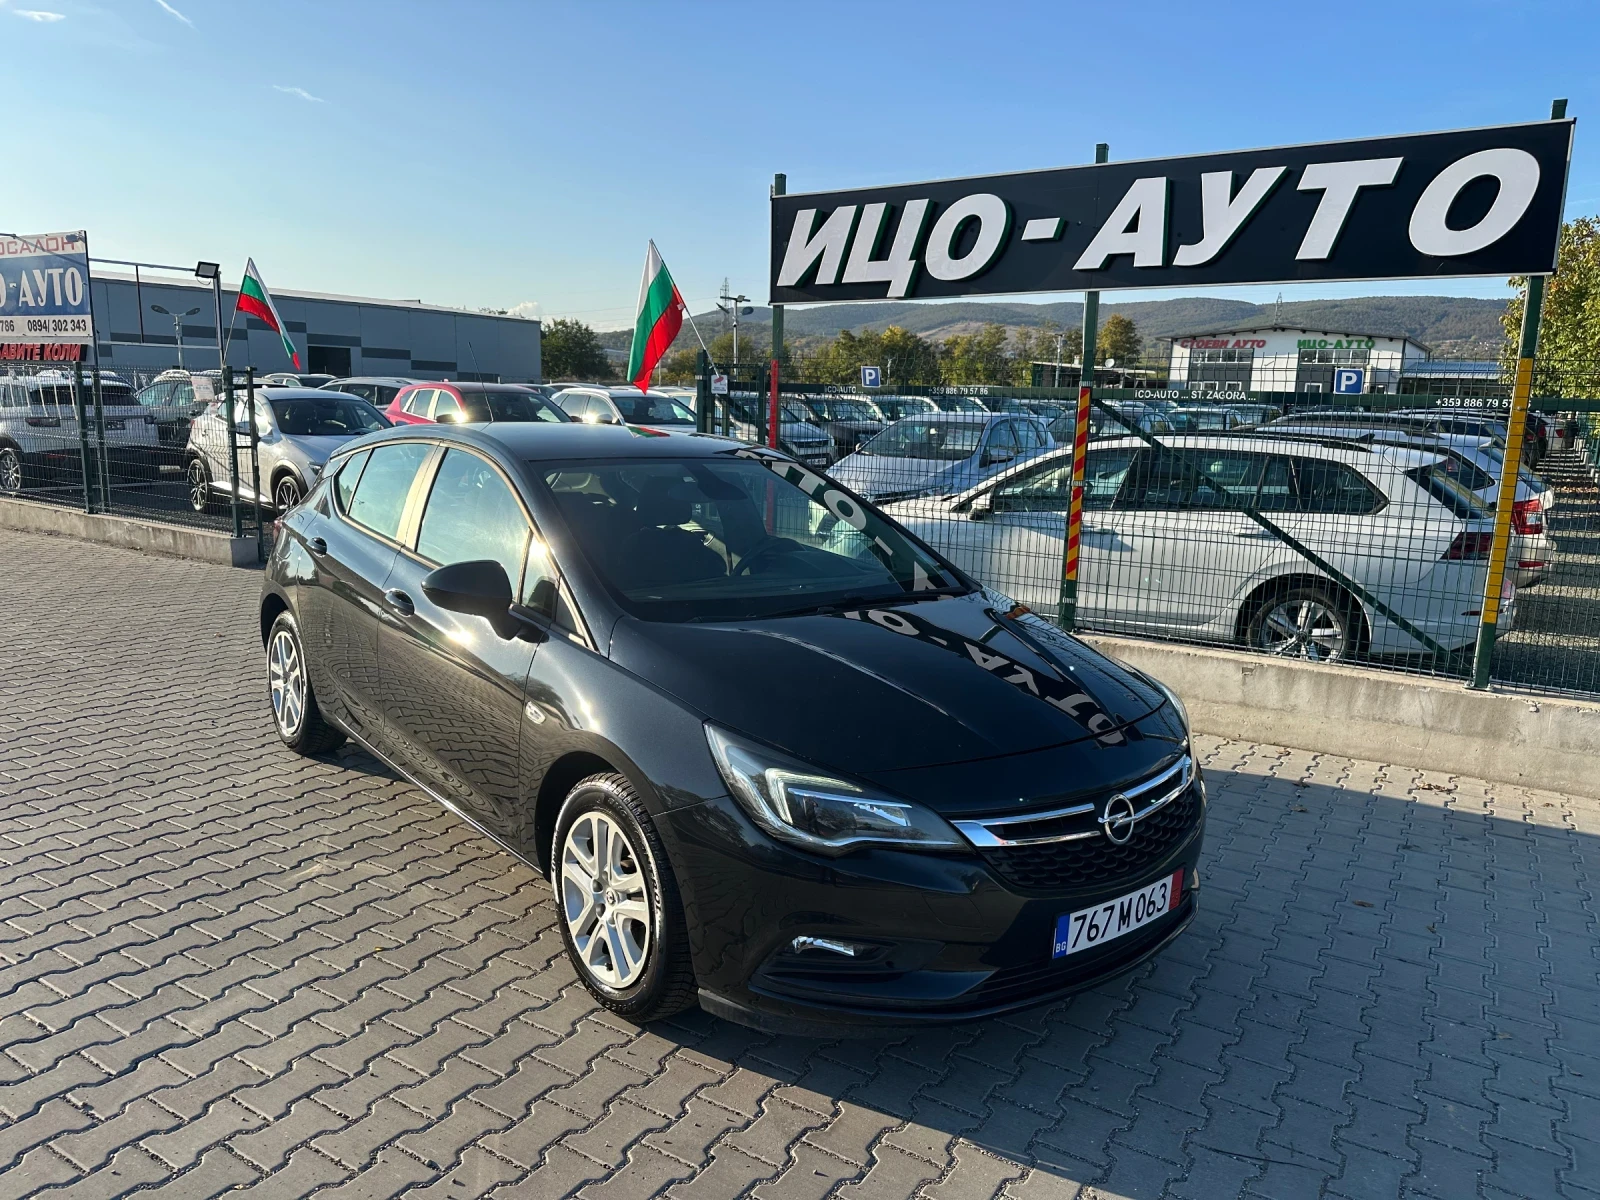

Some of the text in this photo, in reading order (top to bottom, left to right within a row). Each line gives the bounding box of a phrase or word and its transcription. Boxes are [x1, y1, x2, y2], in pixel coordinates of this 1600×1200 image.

[776, 147, 1541, 298] ИЦО-АУТО
[52, 319, 68, 332] 302
[70, 319, 87, 332] 343
[1232, 339, 1267, 349] АУТО
[1296, 339, 1376, 349] ИЦО-АУТО
[0, 343, 81, 361] АВИТЕ КОЛИ
[865, 369, 876, 385] P
[1340, 372, 1357, 391] P
[1206, 391, 1246, 400] ZAGORA
[1435, 398, 1461, 407] +359
[1463, 399, 1483, 407] 886
[1486, 399, 1499, 408] 79
[1055, 941, 1067, 953] BG
